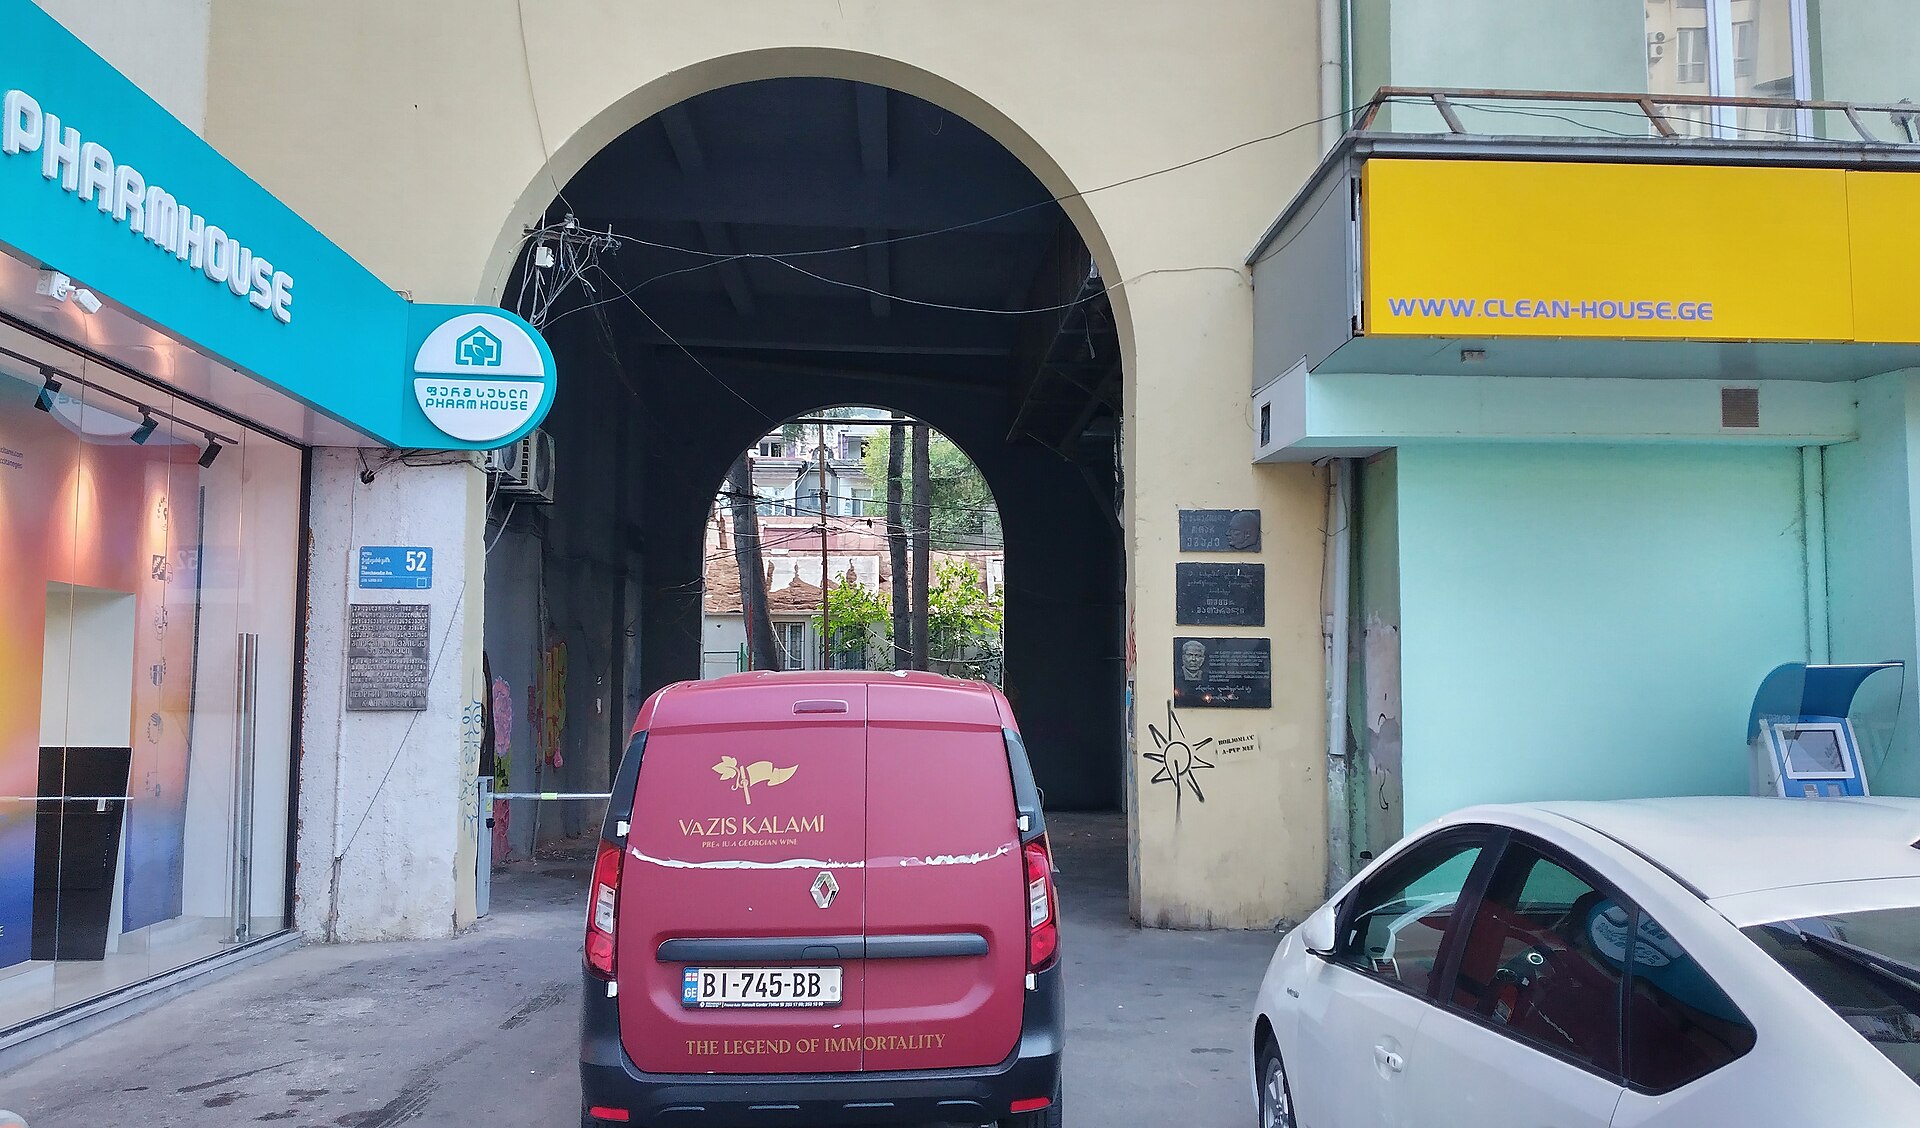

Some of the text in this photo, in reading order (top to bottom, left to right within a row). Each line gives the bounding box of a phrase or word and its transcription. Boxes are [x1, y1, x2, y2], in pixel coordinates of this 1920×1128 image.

[3, 89, 294, 324] PHARMHOUSE
[1389, 298, 1713, 320] WWW.CLEAN-HOUSE.GE
[425, 398, 528, 410] PHARM HOUSE
[405, 551, 428, 572] 52
[742, 814, 824, 835] KALAMI
[738, 839, 778, 848] GEORGIAN
[779, 838, 798, 846] WINE
[684, 987, 698, 999] GE
[702, 972, 822, 998] BI-745-BB
[686, 1033, 946, 1056] THE LEGEND OF IMMORTALITY
